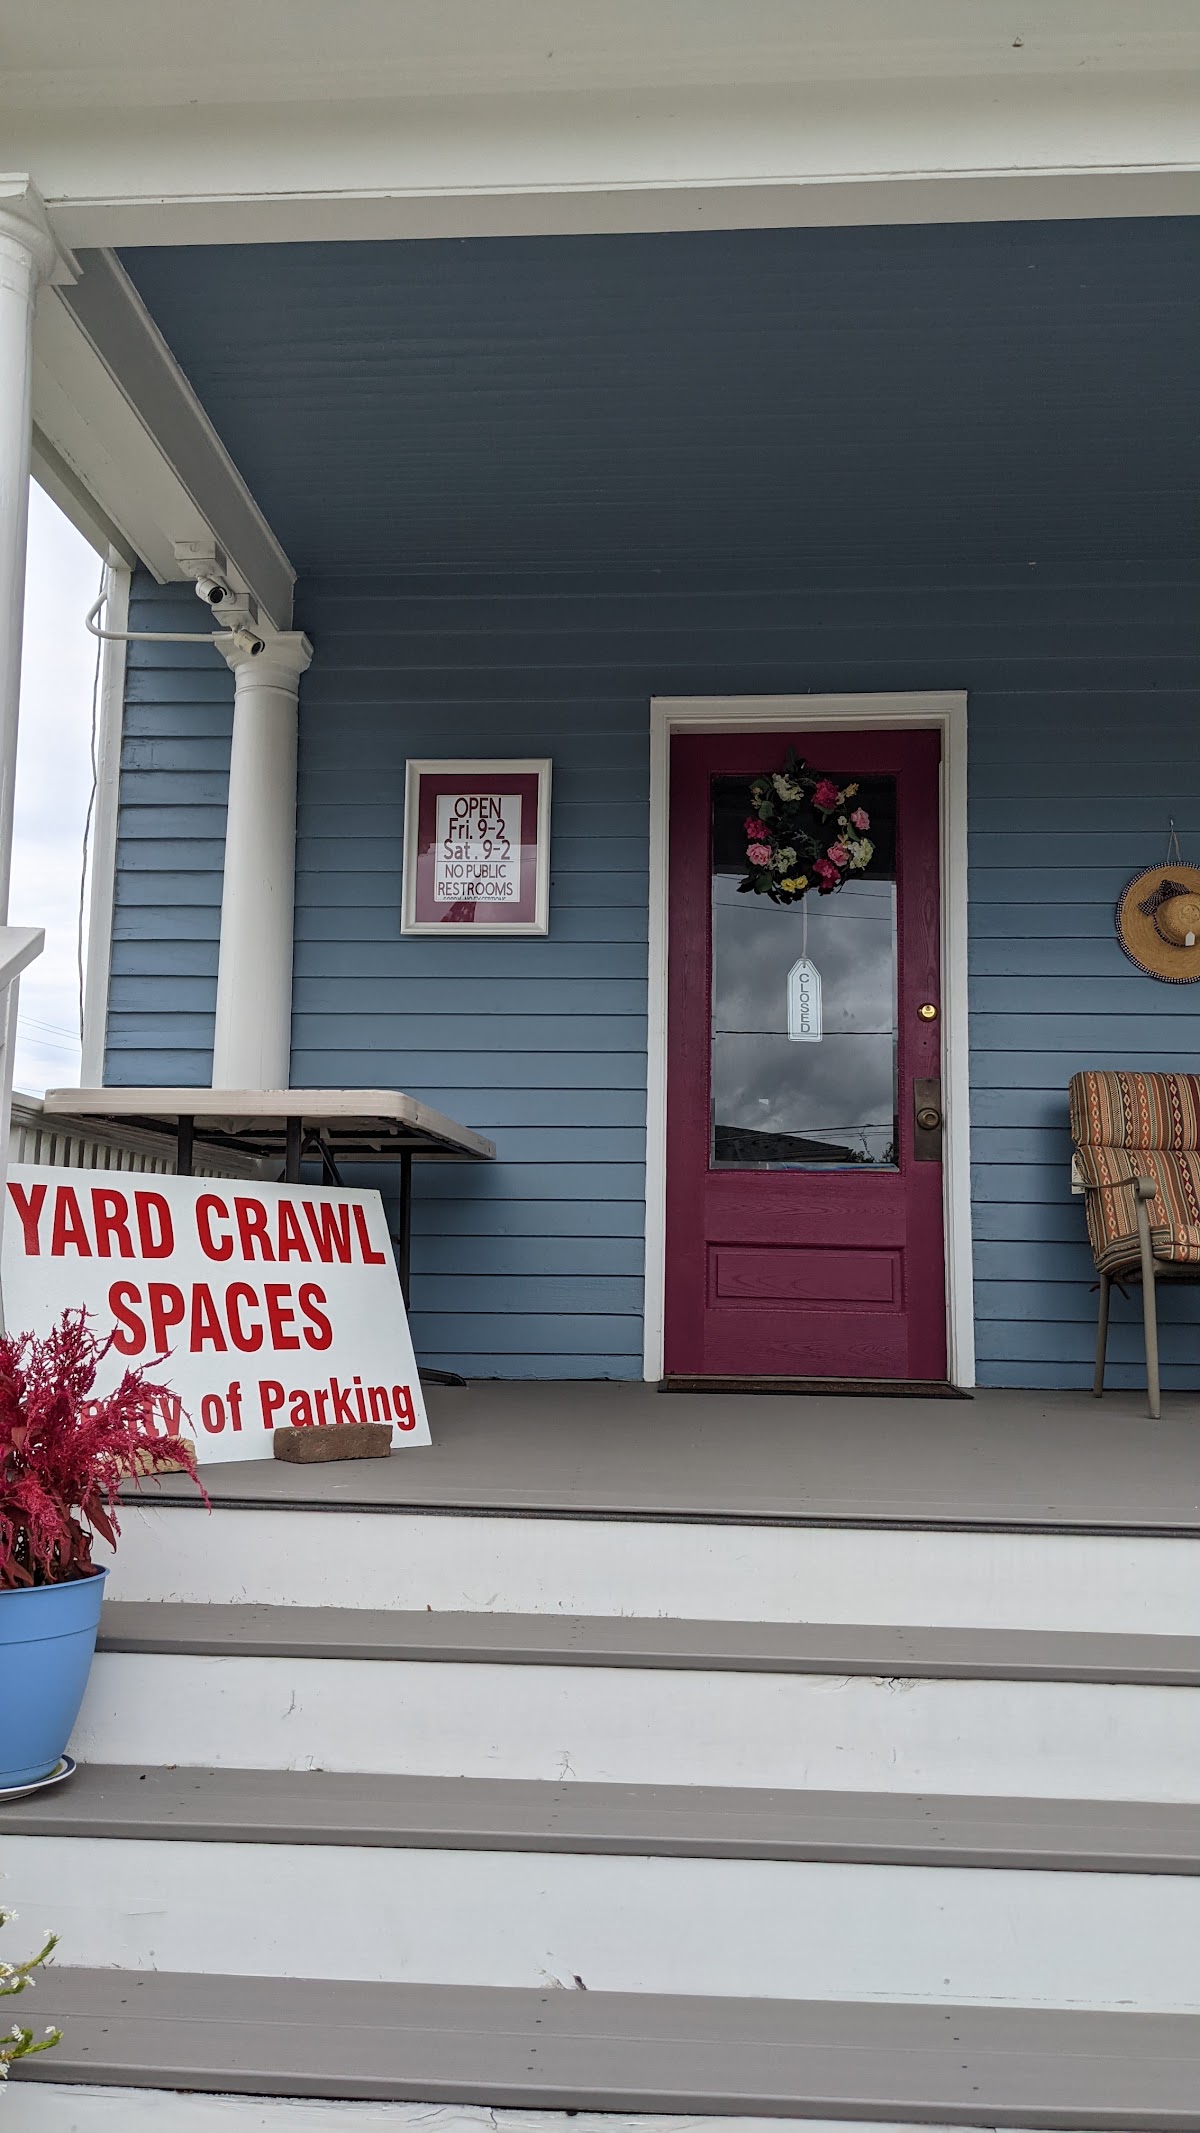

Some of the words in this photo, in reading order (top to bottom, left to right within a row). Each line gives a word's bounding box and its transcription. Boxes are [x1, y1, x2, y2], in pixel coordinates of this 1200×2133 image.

[454, 797, 502, 819] OPEN
[449, 818, 473, 840] Fri.
[477, 818, 506, 840] 9-2
[482, 839, 511, 860] 9-2
[445, 864, 464, 879] NO
[466, 864, 507, 879] PUBLIC
[438, 881, 513, 897] RESTROOMS
[799, 973, 811, 1033] CLOSED
[6, 1182, 175, 1259] YARD
[194, 1193, 387, 1265] CRAWL
[108, 1280, 333, 1356] SPACES
[201, 1381, 243, 1434] of
[258, 1376, 417, 1431] Parking
